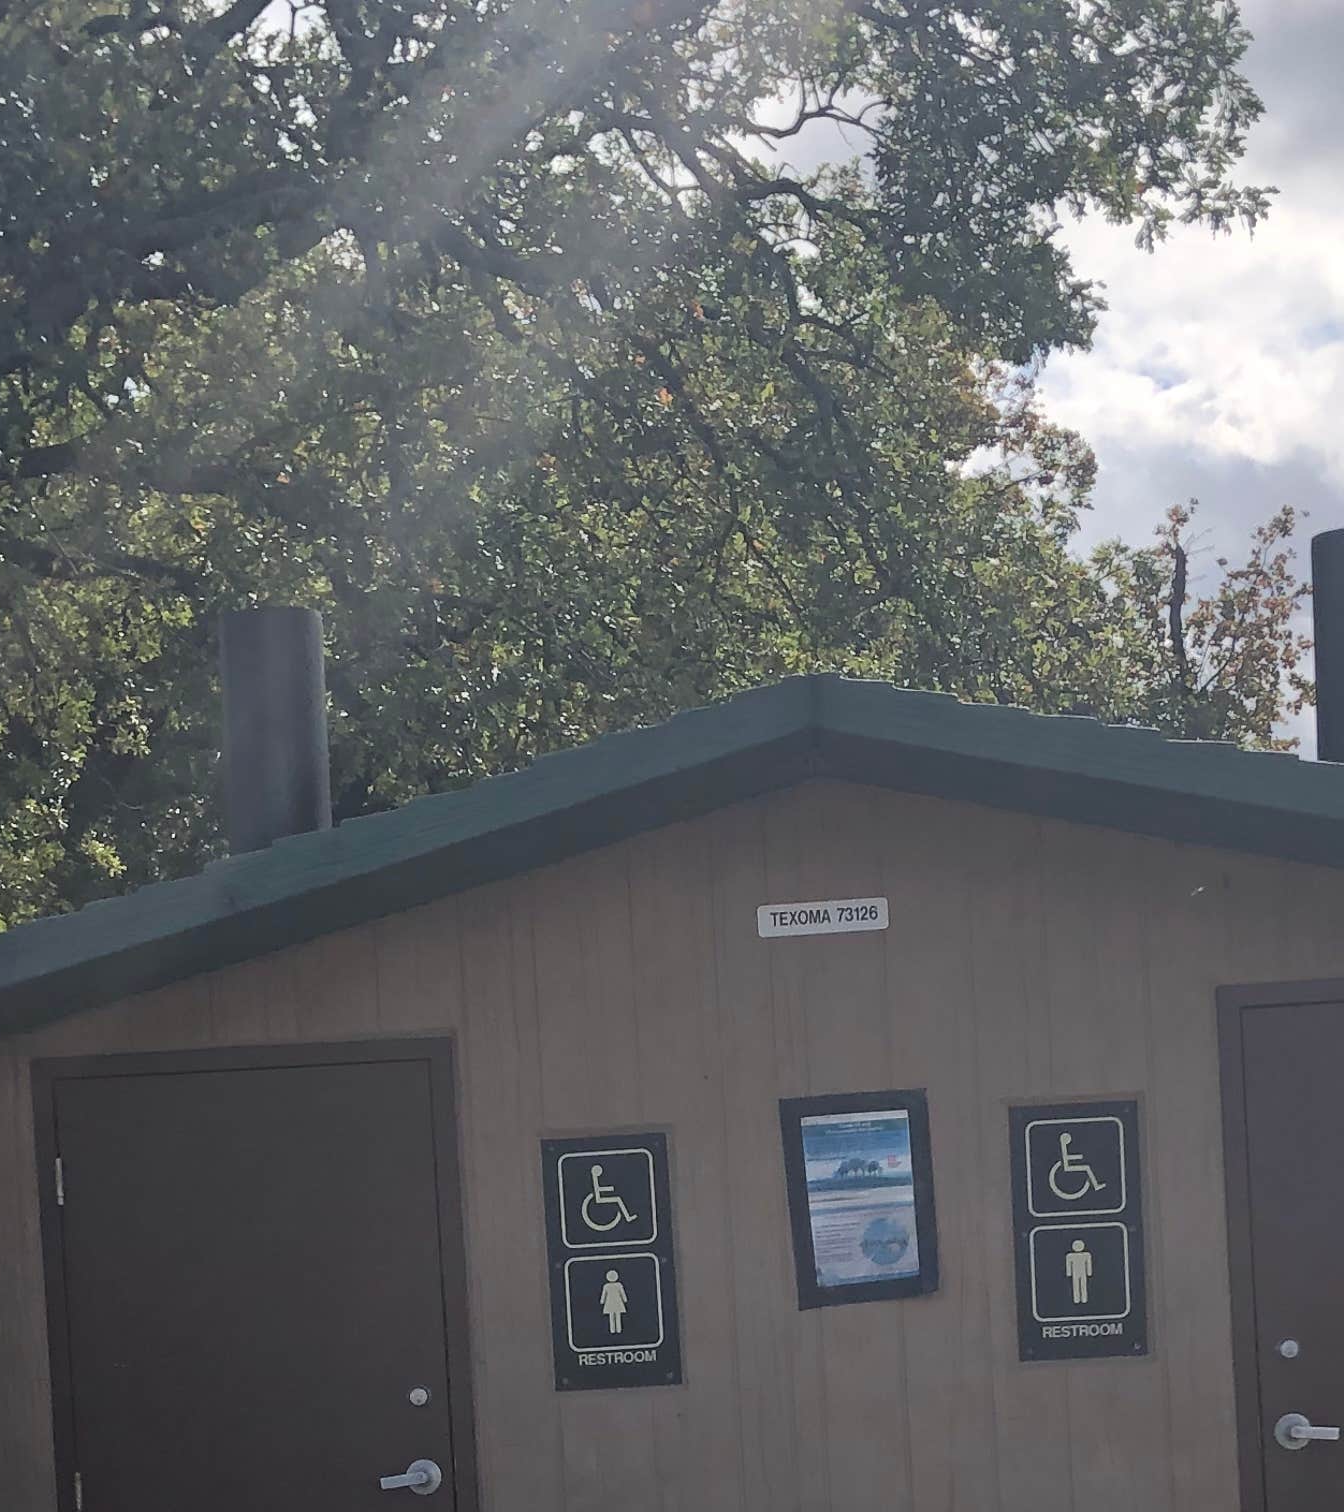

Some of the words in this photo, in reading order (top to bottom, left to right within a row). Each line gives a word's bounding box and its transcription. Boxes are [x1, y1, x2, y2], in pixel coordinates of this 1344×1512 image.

[770, 909, 831, 927] TEXOMA
[837, 905, 878, 922] 73126
[1042, 1322, 1123, 1338] RESTROOM
[578, 1349, 657, 1366] RESTROOM
